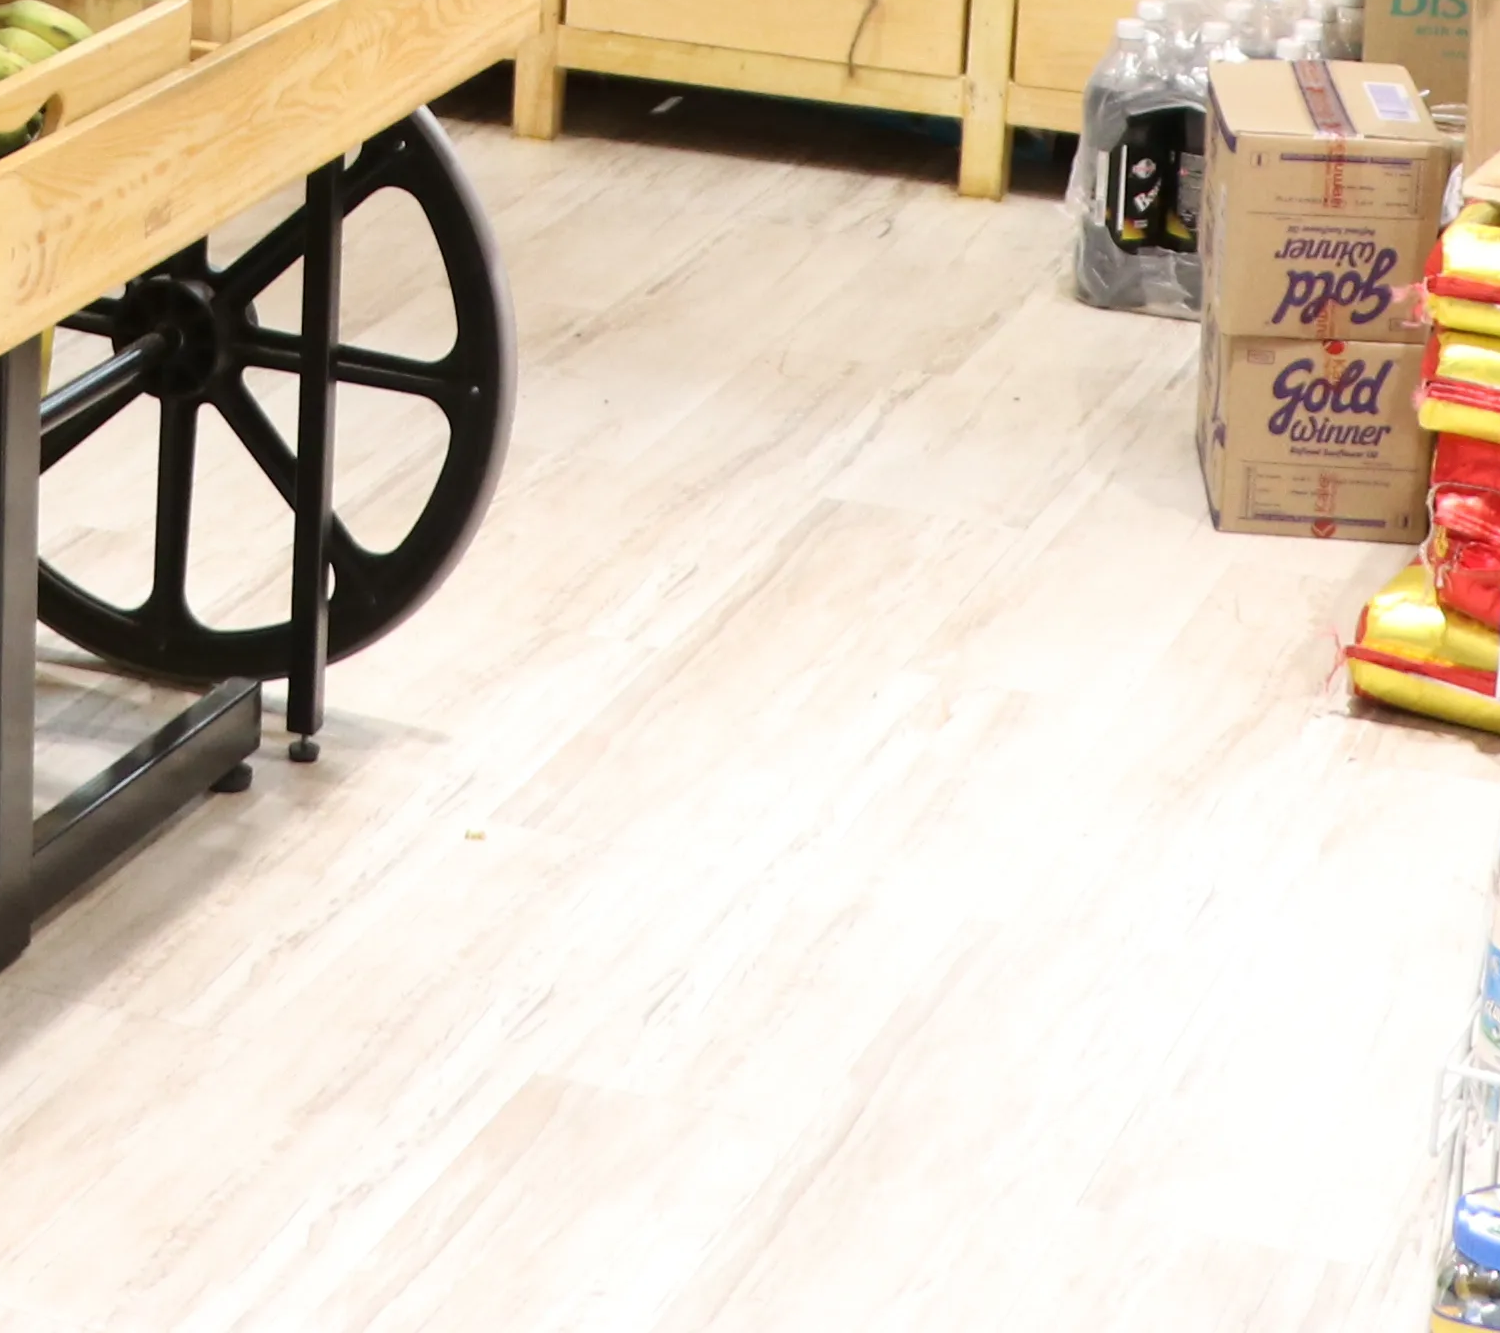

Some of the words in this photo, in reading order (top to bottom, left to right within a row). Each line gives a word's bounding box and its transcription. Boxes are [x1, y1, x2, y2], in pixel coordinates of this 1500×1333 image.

[1274, 238, 1376, 266] Winner
[1272, 248, 1397, 325] Gold
[1268, 358, 1394, 434] Gold
[1290, 415, 1391, 447] Winner
